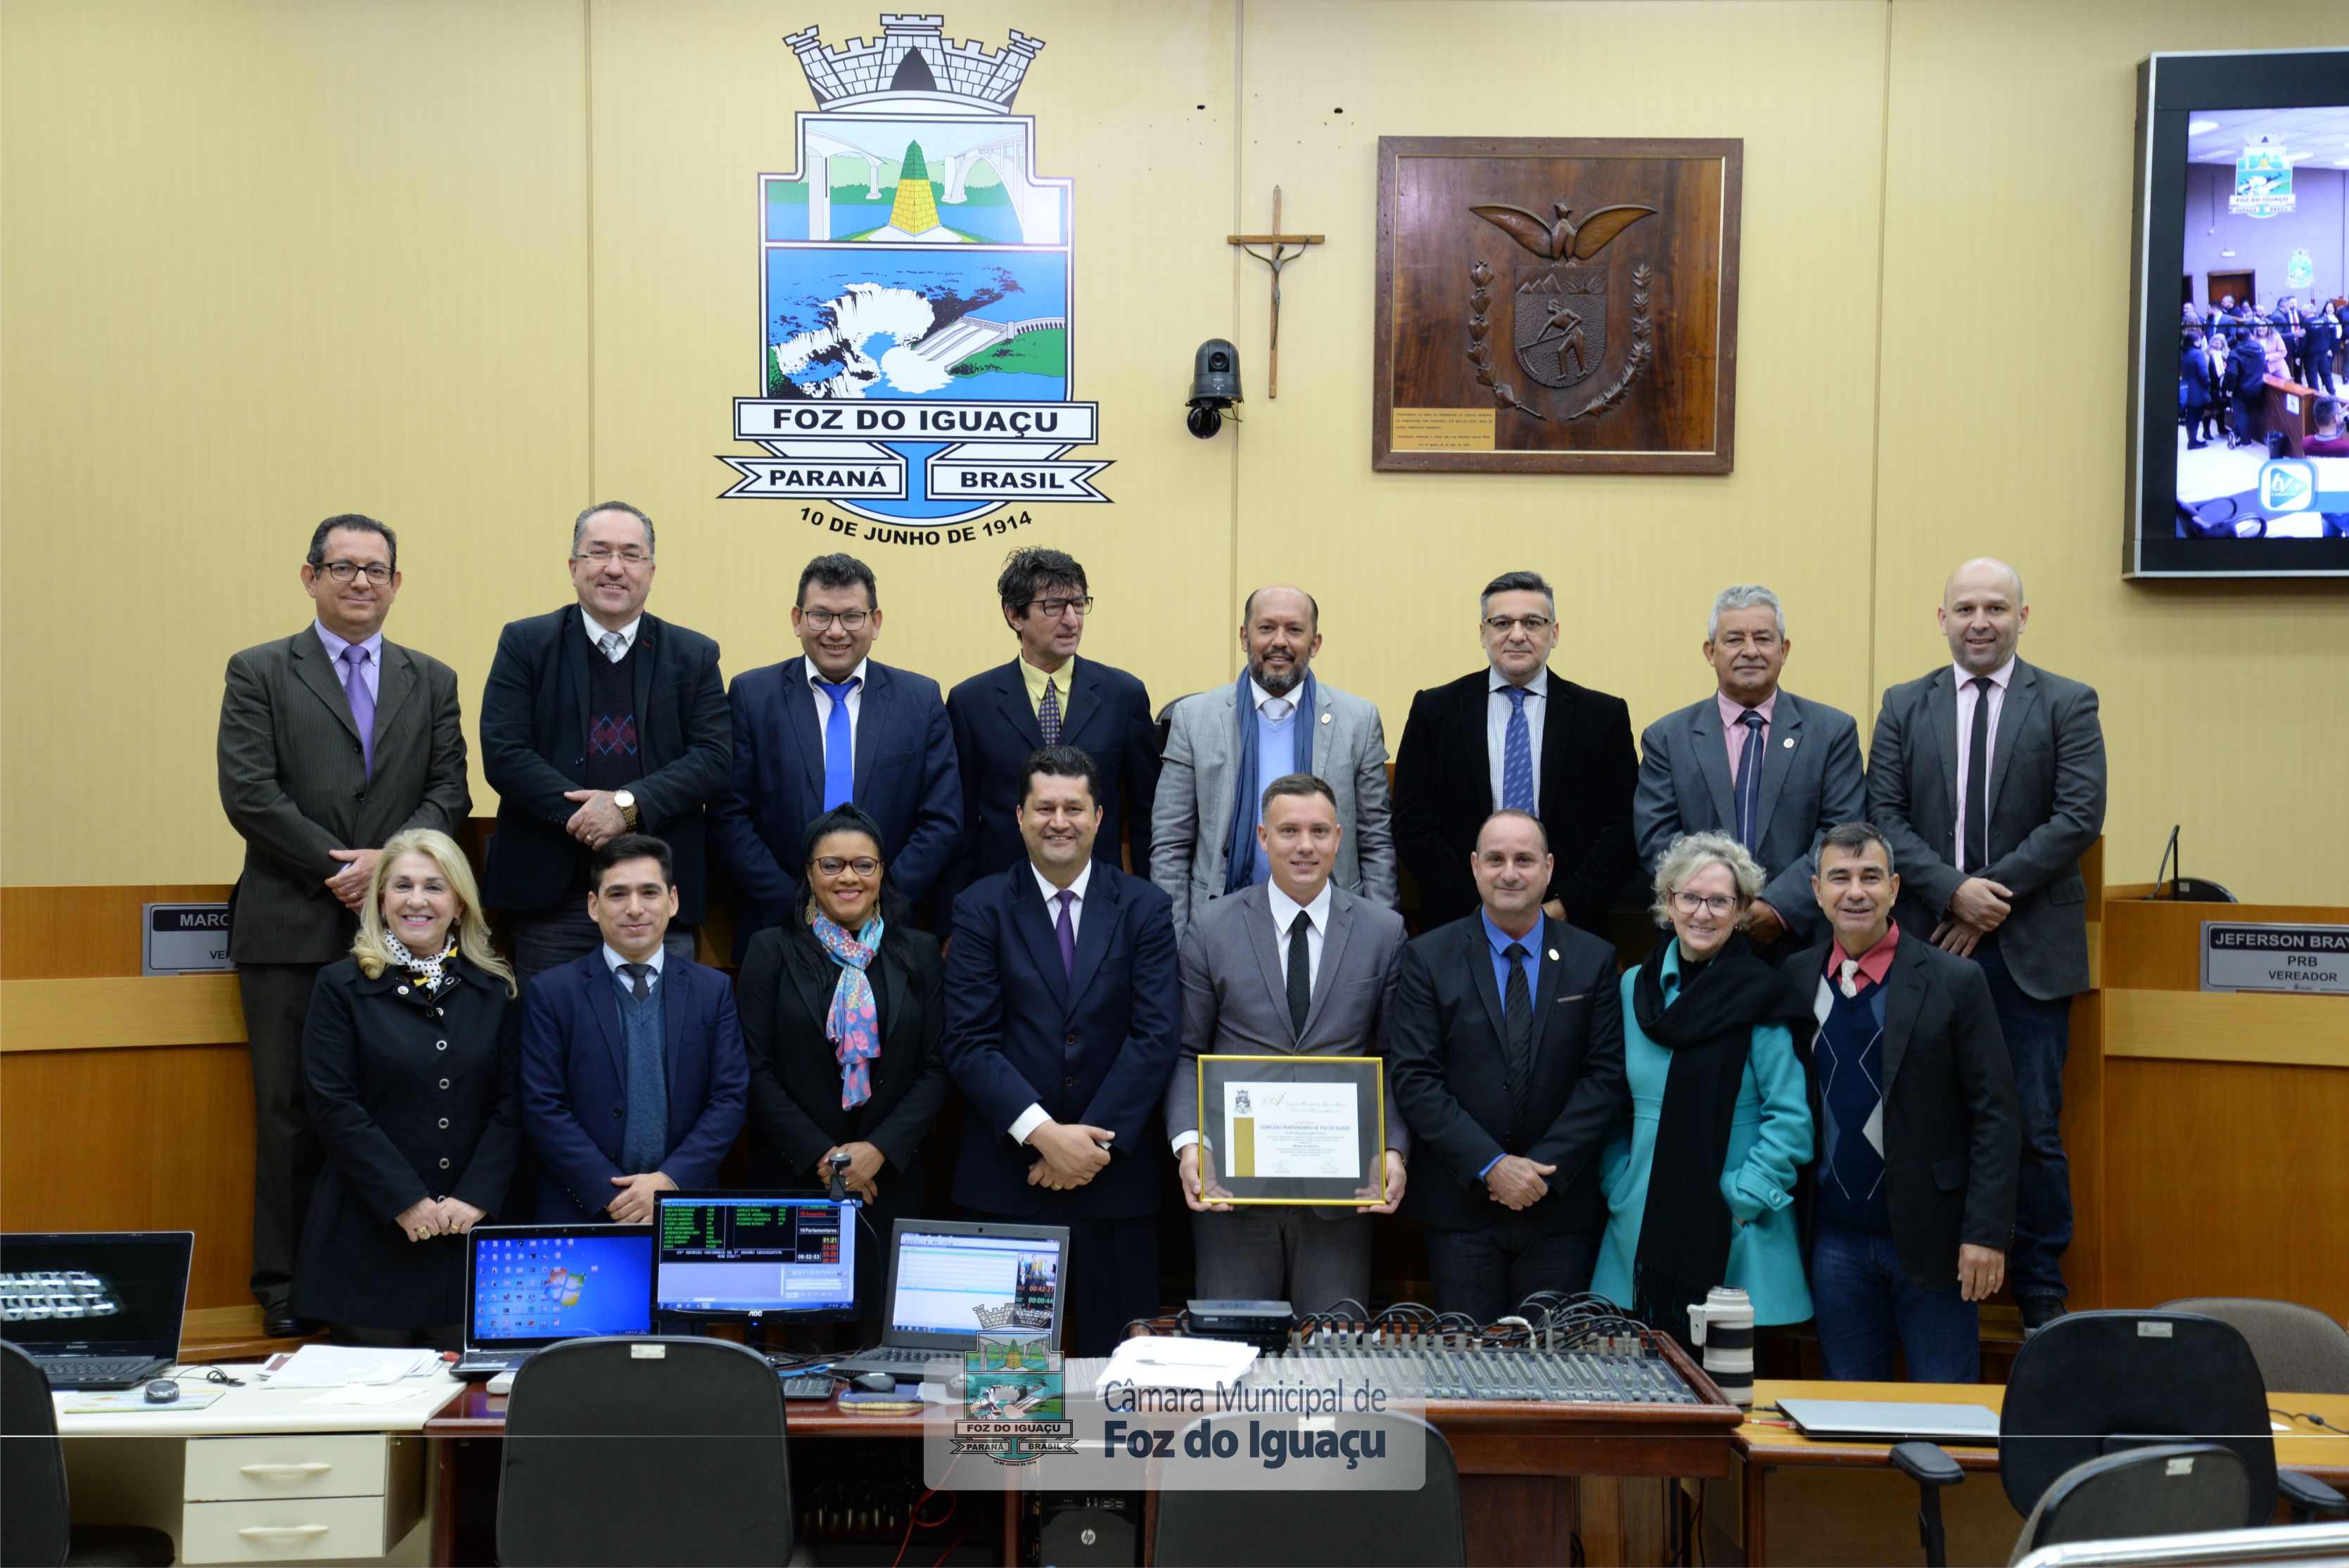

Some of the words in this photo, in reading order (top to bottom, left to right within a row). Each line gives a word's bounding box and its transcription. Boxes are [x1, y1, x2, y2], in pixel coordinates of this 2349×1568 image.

[773, 409, 844, 430] FOZ
[856, 409, 905, 431] DO
[919, 410, 1058, 438] IGUAÇU
[770, 467, 887, 487] PARANÁ
[960, 471, 1064, 490] BRASIL
[800, 506, 824, 526] 10
[829, 517, 858, 537] DE
[863, 526, 941, 546] JUNHO
[947, 527, 976, 544] DE
[982, 511, 1032, 537] 1914
[2215, 933, 2304, 948] JEFERSON
[2288, 955, 2318, 967] PRB
[2268, 970, 2338, 983] VEREADOR
[1083, 1529, 1095, 1545] hp
